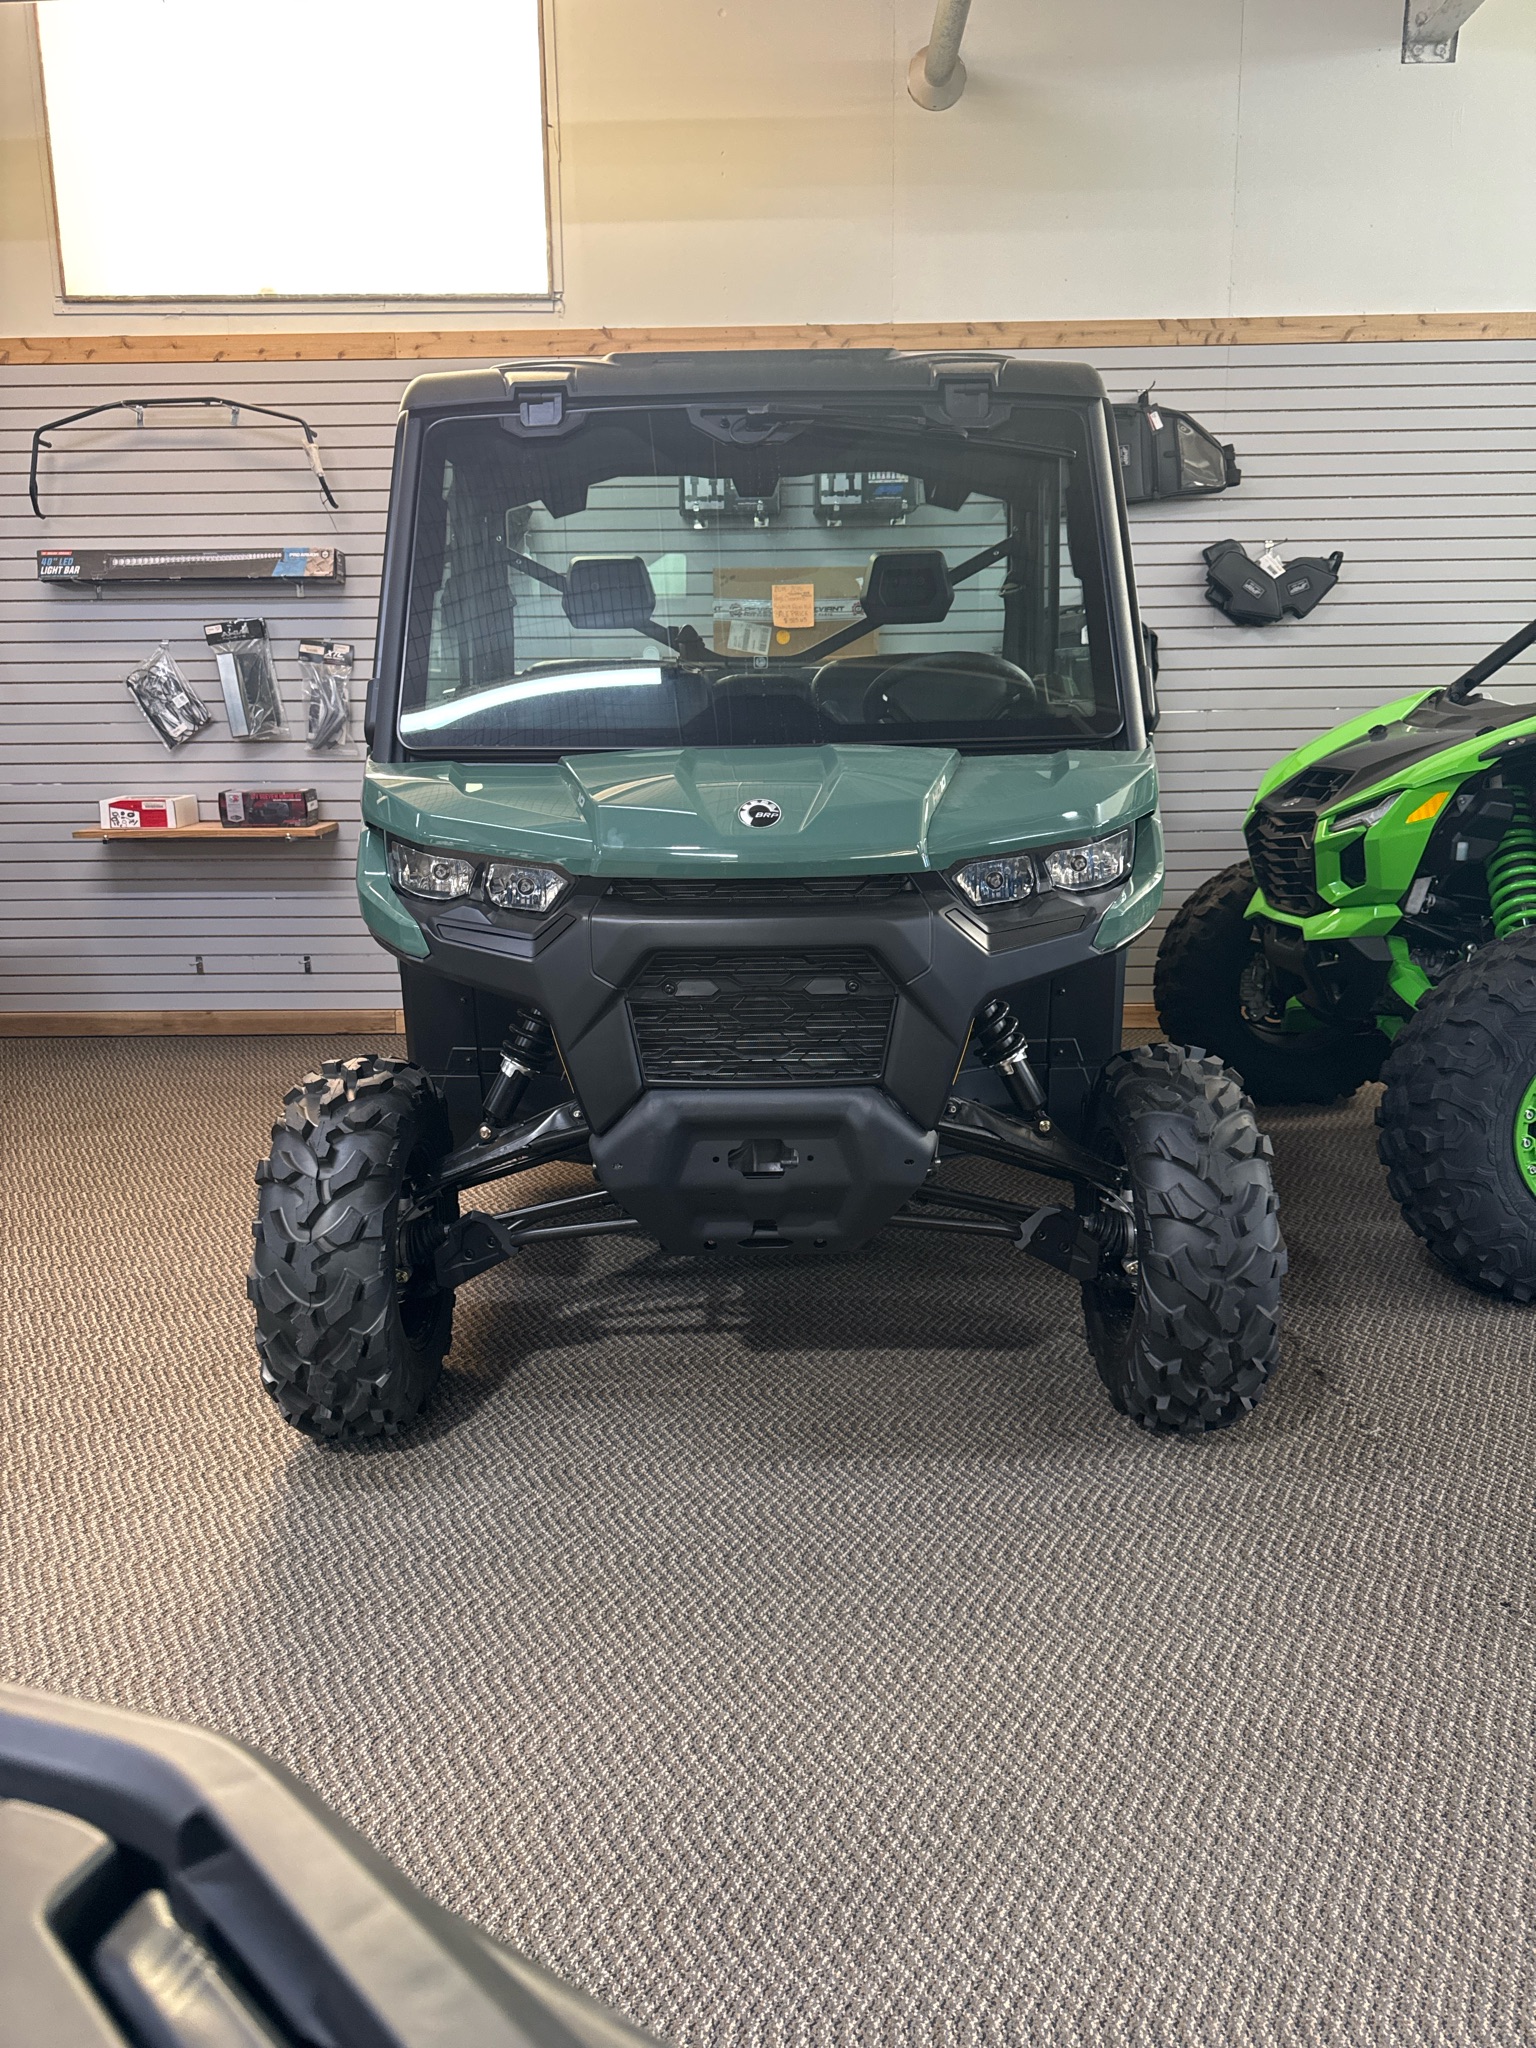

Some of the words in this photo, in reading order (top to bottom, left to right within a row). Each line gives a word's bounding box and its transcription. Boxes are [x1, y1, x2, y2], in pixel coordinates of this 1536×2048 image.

[59, 557, 74, 566] LED
[40, 566, 63, 575] LIGHT
[64, 565, 80, 574] BAR
